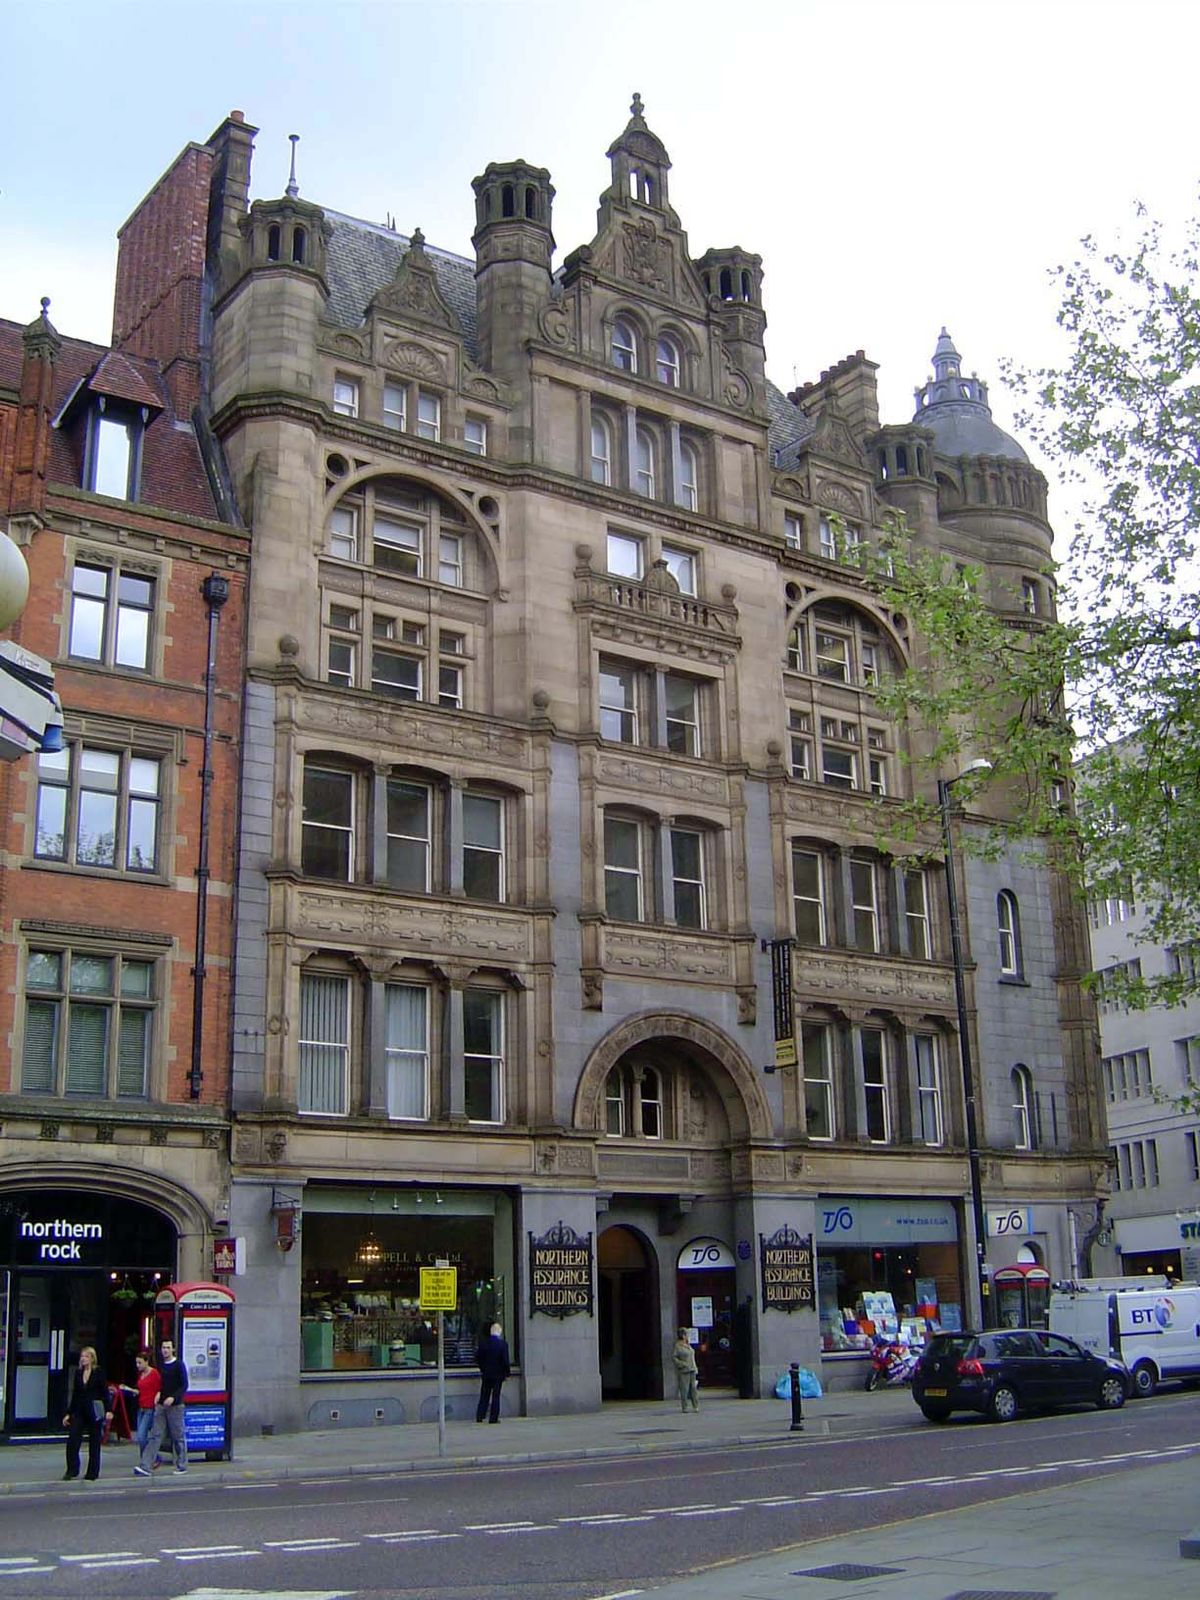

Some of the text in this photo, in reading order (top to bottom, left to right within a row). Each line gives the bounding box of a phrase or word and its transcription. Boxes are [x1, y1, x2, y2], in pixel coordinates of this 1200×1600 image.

[823, 1206, 853, 1233] TSO
[996, 1210, 1023, 1234] TSO
[21, 1220, 102, 1238] northern
[40, 1241, 81, 1259] rock
[535, 1249, 589, 1266] NORTHERN
[692, 1245, 720, 1265] TSO
[766, 1249, 810, 1265] NORTHERN
[533, 1269, 590, 1286] ASSURANCE
[764, 1268, 812, 1283] ASSURANCE
[535, 1289, 588, 1306] BUILDINGS
[766, 1286, 811, 1301] BUILDINGS
[1132, 1309, 1153, 1324] BT
